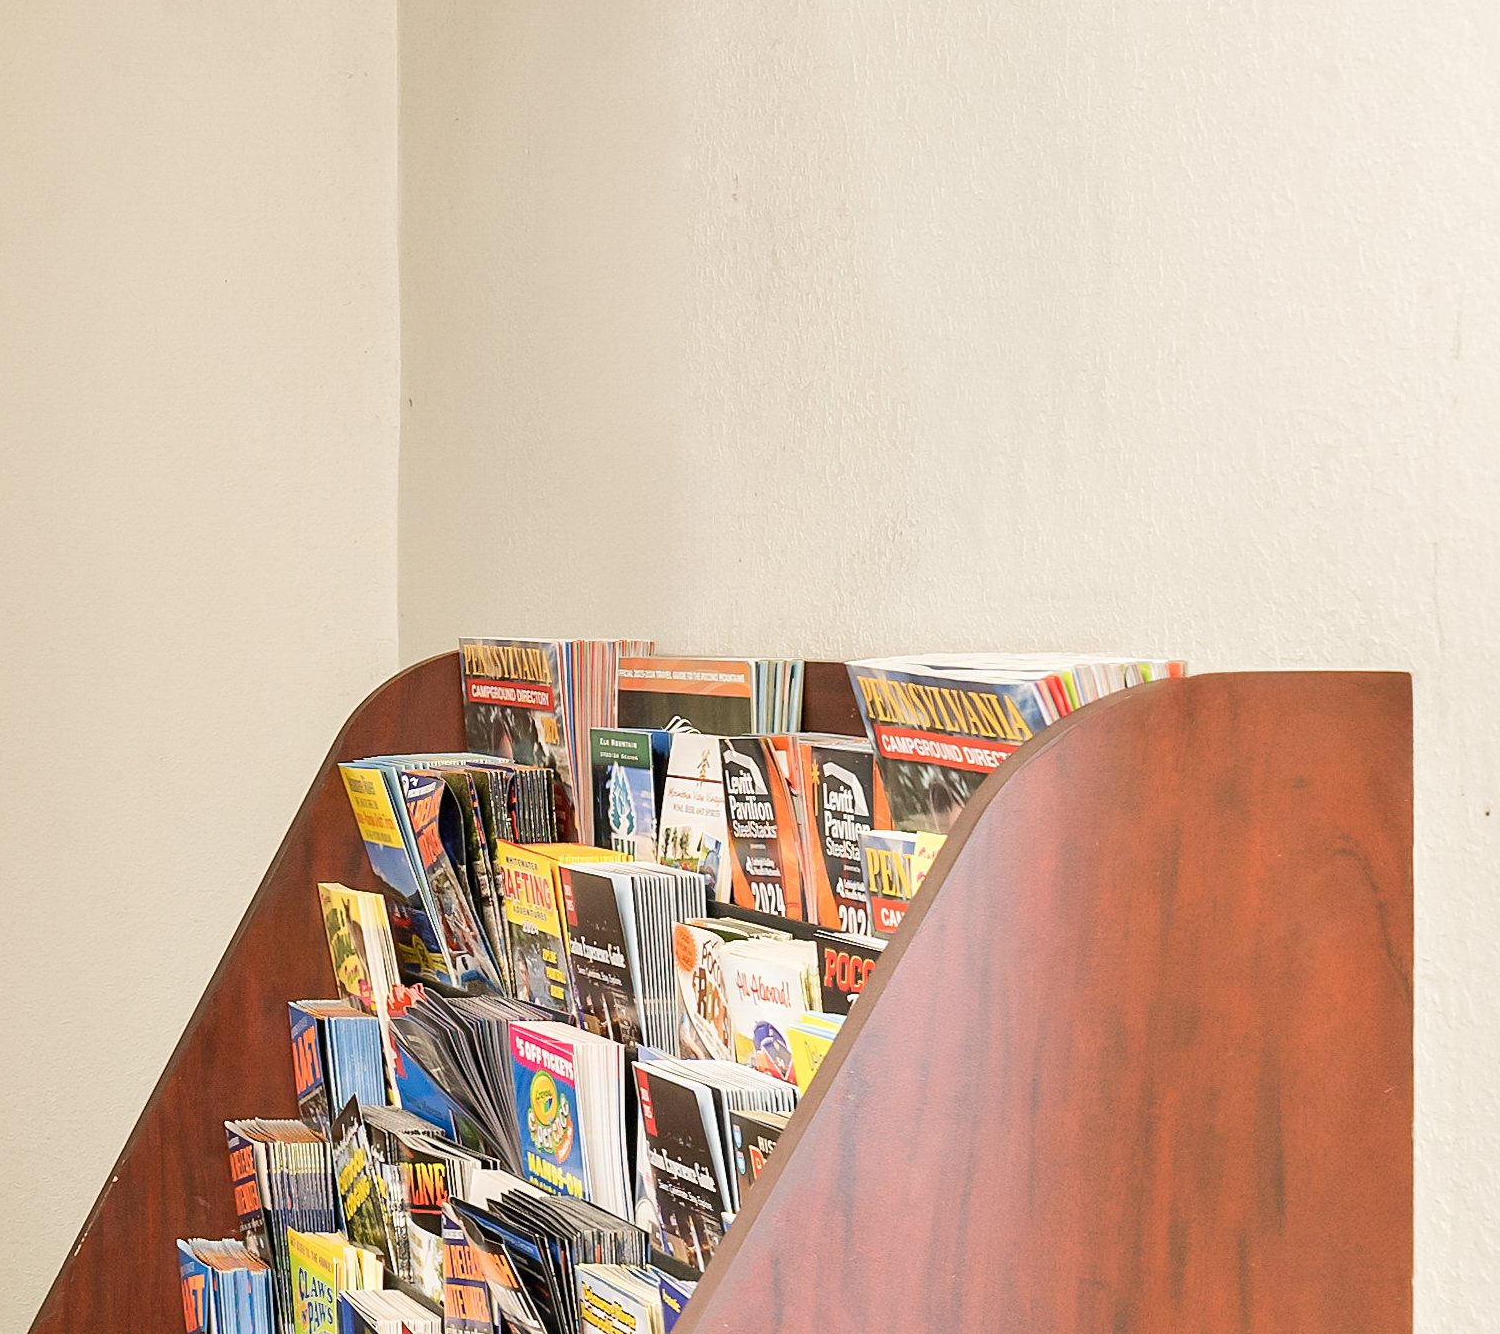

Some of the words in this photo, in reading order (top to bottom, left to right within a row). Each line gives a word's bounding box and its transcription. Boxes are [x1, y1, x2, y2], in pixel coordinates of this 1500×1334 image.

[463, 644, 552, 684] PENNSYLVANIA
[857, 675, 1033, 741] PENNSYLVANIA
[881, 733, 962, 764] CAMPGROUND
[962, 746, 1011, 769] DIRECT
[726, 769, 755, 795] Levitt
[823, 782, 854, 814] Levitt
[729, 795, 774, 822] Pavilion
[824, 813, 872, 837] Pavilion
[733, 822, 777, 839] SteelStacks
[751, 880, 786, 917] 2024
[525, 1041, 542, 1068] OFF
[541, 1051, 575, 1081] TICKETS
[298, 1267, 333, 1304] CLAWS
[308, 1301, 333, 1334] PAWS
